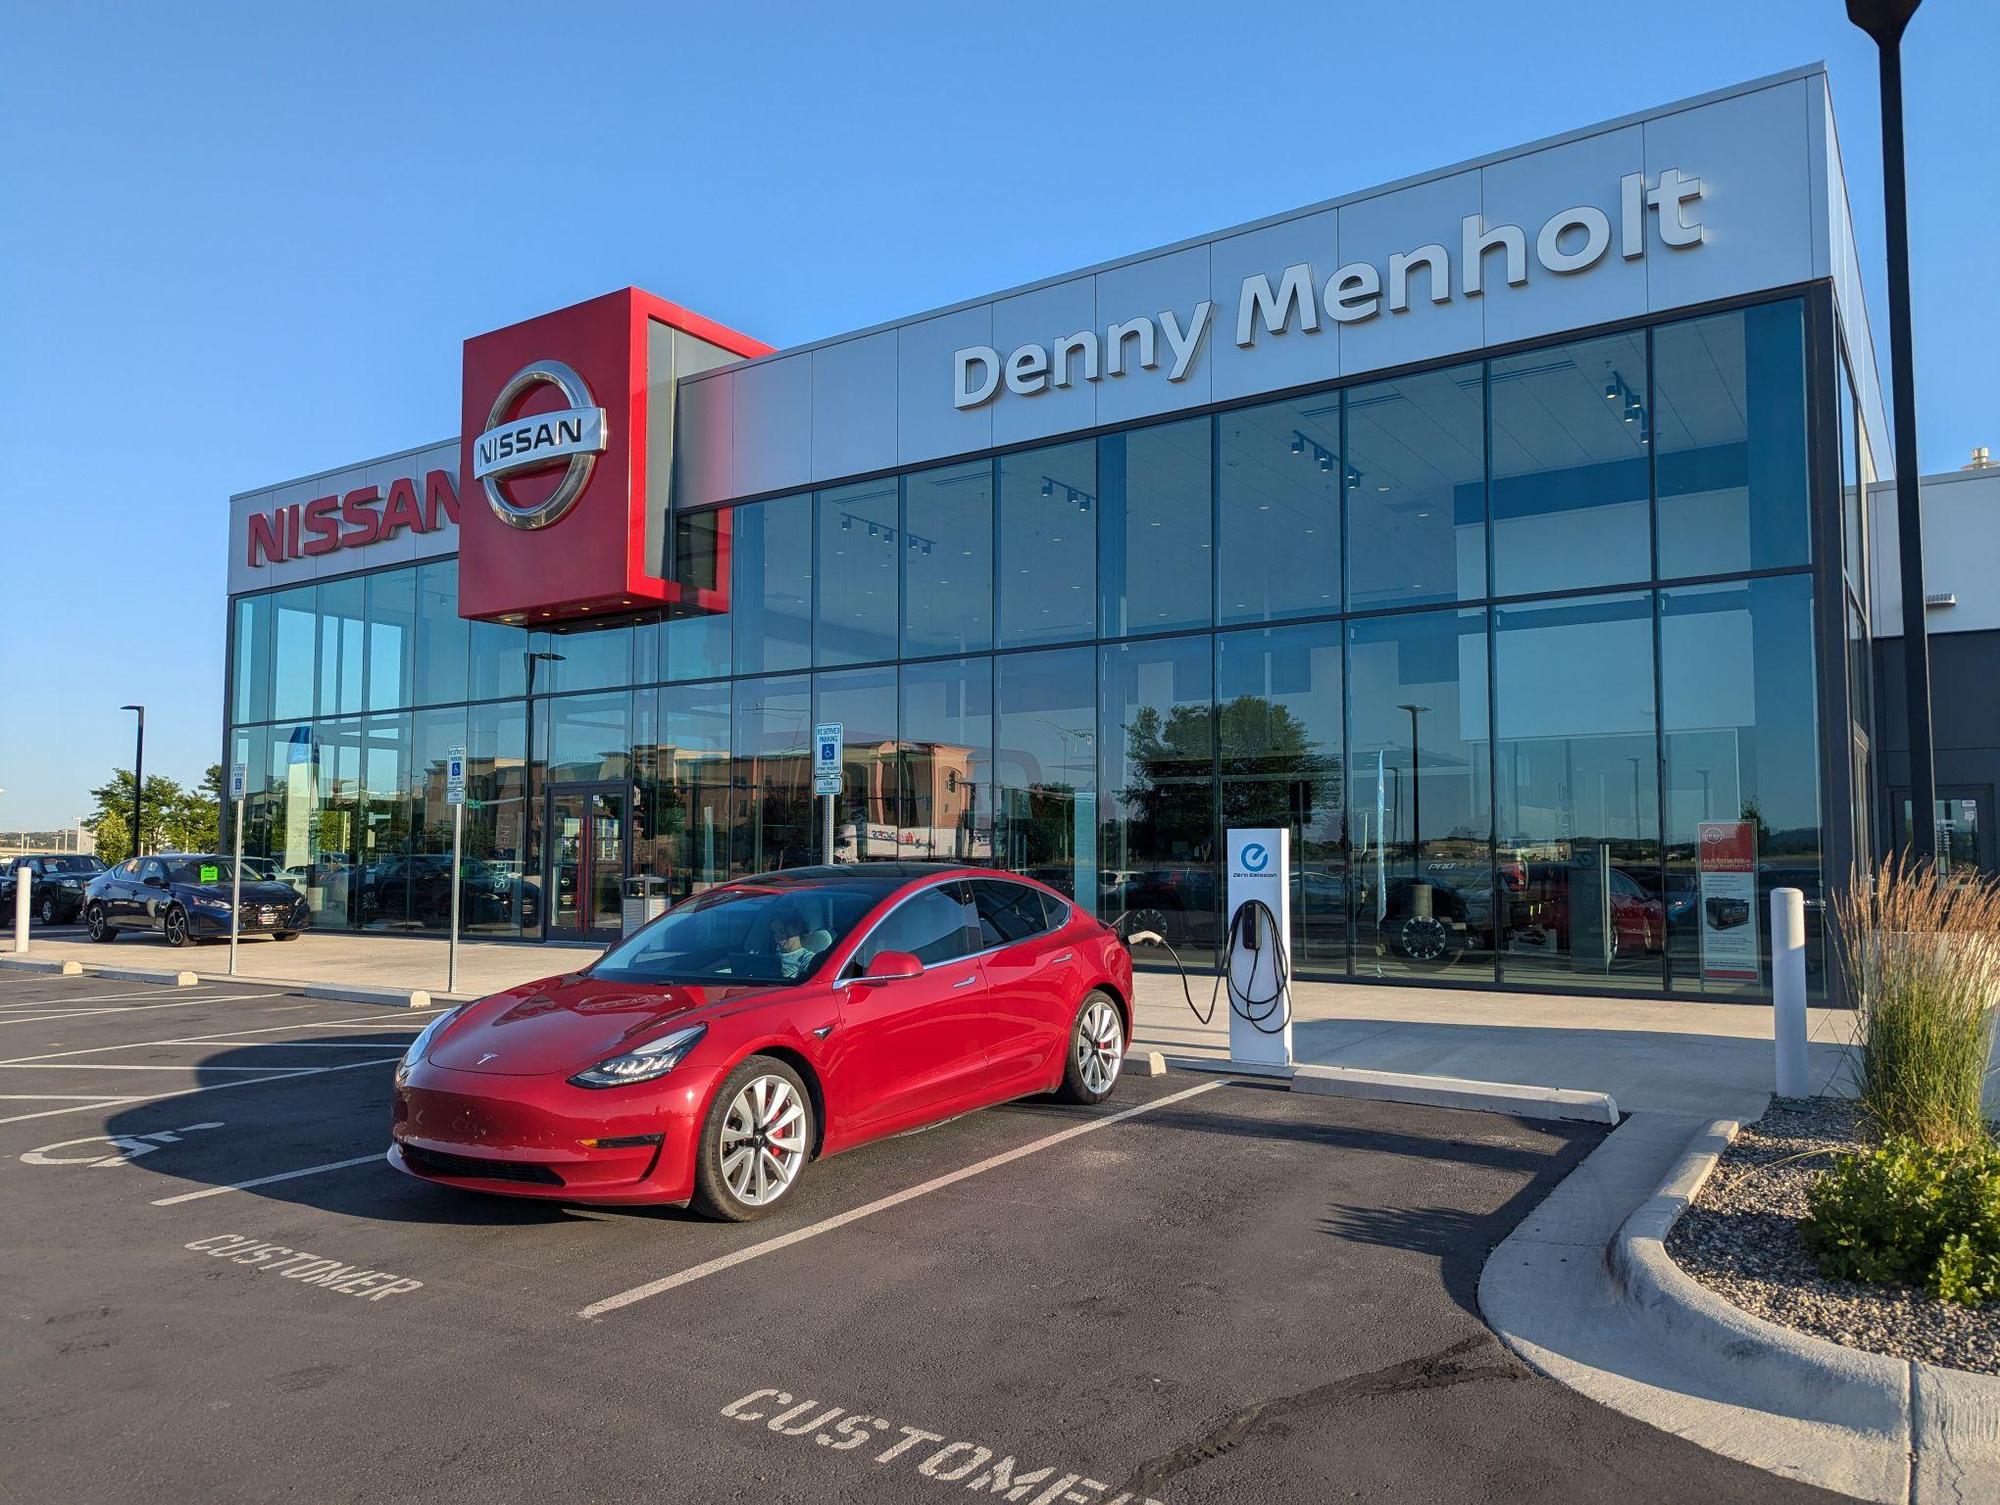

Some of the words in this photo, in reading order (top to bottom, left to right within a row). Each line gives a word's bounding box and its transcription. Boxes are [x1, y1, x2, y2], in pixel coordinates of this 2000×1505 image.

[954, 300, 1214, 410] Denny
[1235, 168, 1704, 348] Menholt
[478, 417, 582, 468] NISSAN
[247, 467, 460, 567] NISSAN
[817, 727, 840, 735] RESERVED
[184, 1234, 424, 1301] CUSTOMER
[720, 1388, 1165, 1505] CUSTOME
